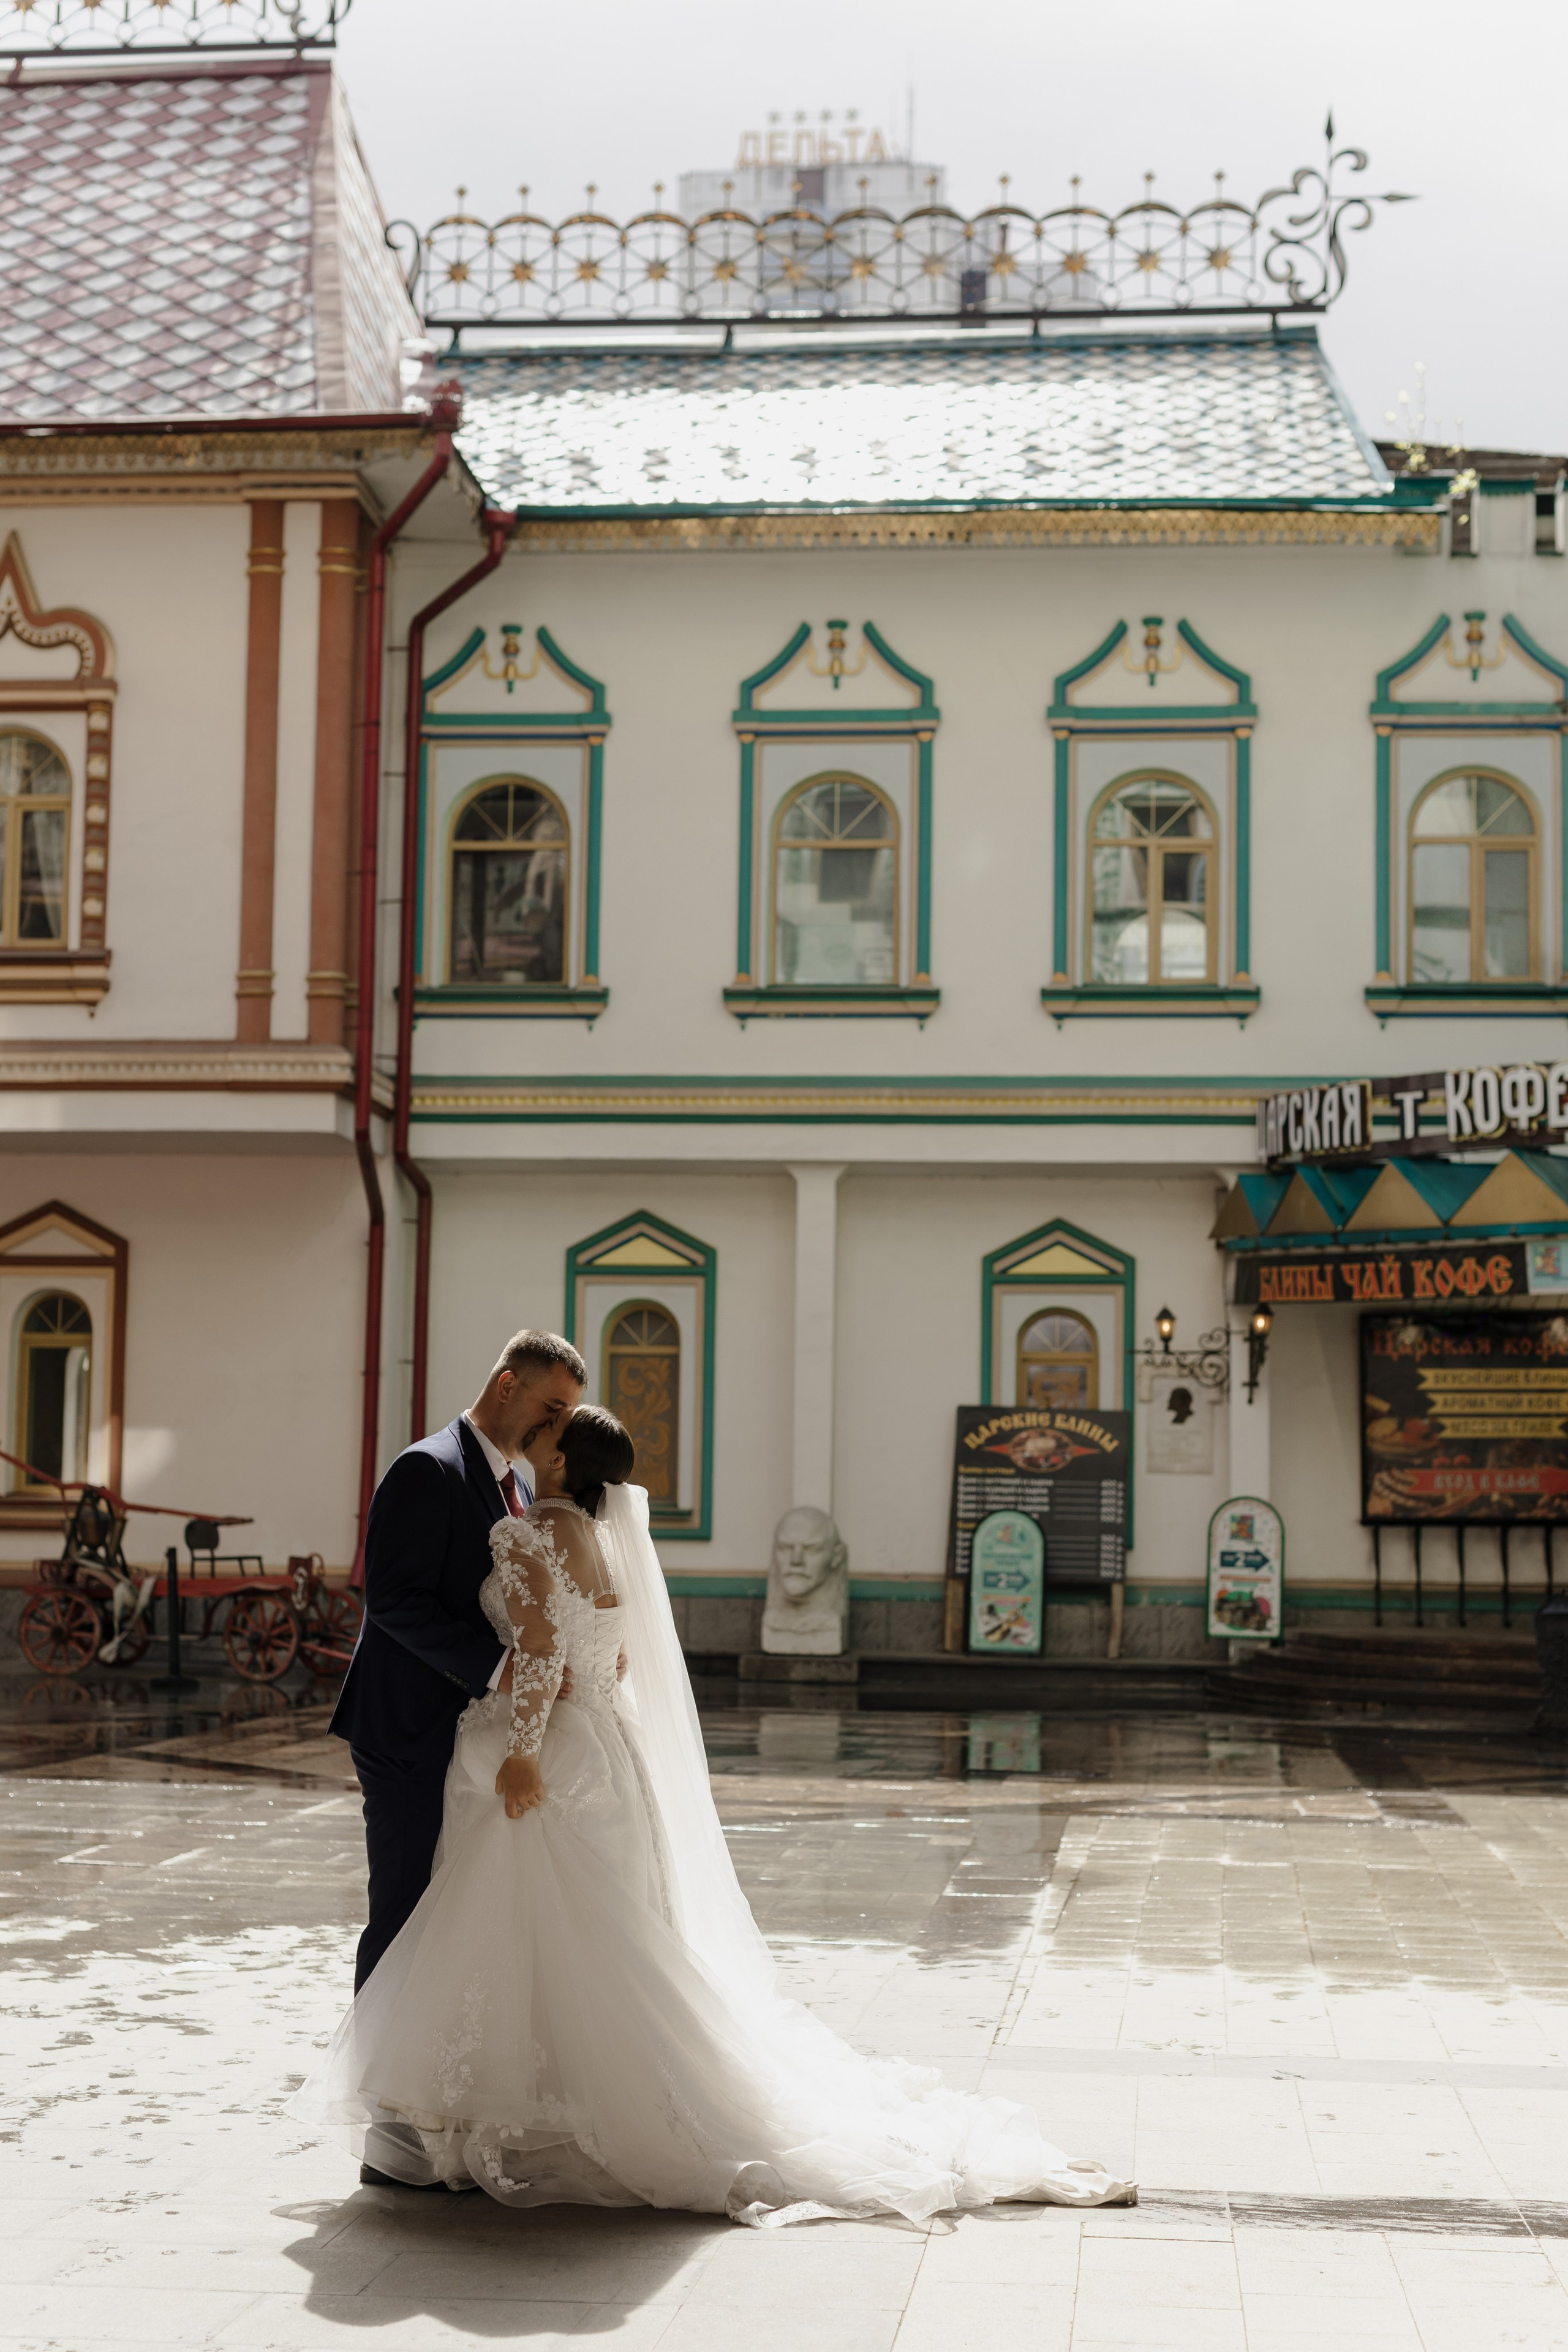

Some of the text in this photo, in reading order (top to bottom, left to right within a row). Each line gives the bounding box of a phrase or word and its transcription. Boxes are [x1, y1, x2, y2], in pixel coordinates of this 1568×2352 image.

[737, 129, 887, 168] ДЕЛЬТА
[1256, 1084, 1362, 1165] ЦАРСКАЯ
[1259, 1254, 1513, 1302] БЛИНЫ ЧАЙ КОФЕ
[963, 1411, 1052, 1450] ЦАРСКИЕ
[1054, 1413, 1121, 1454] БЛИНЫ
